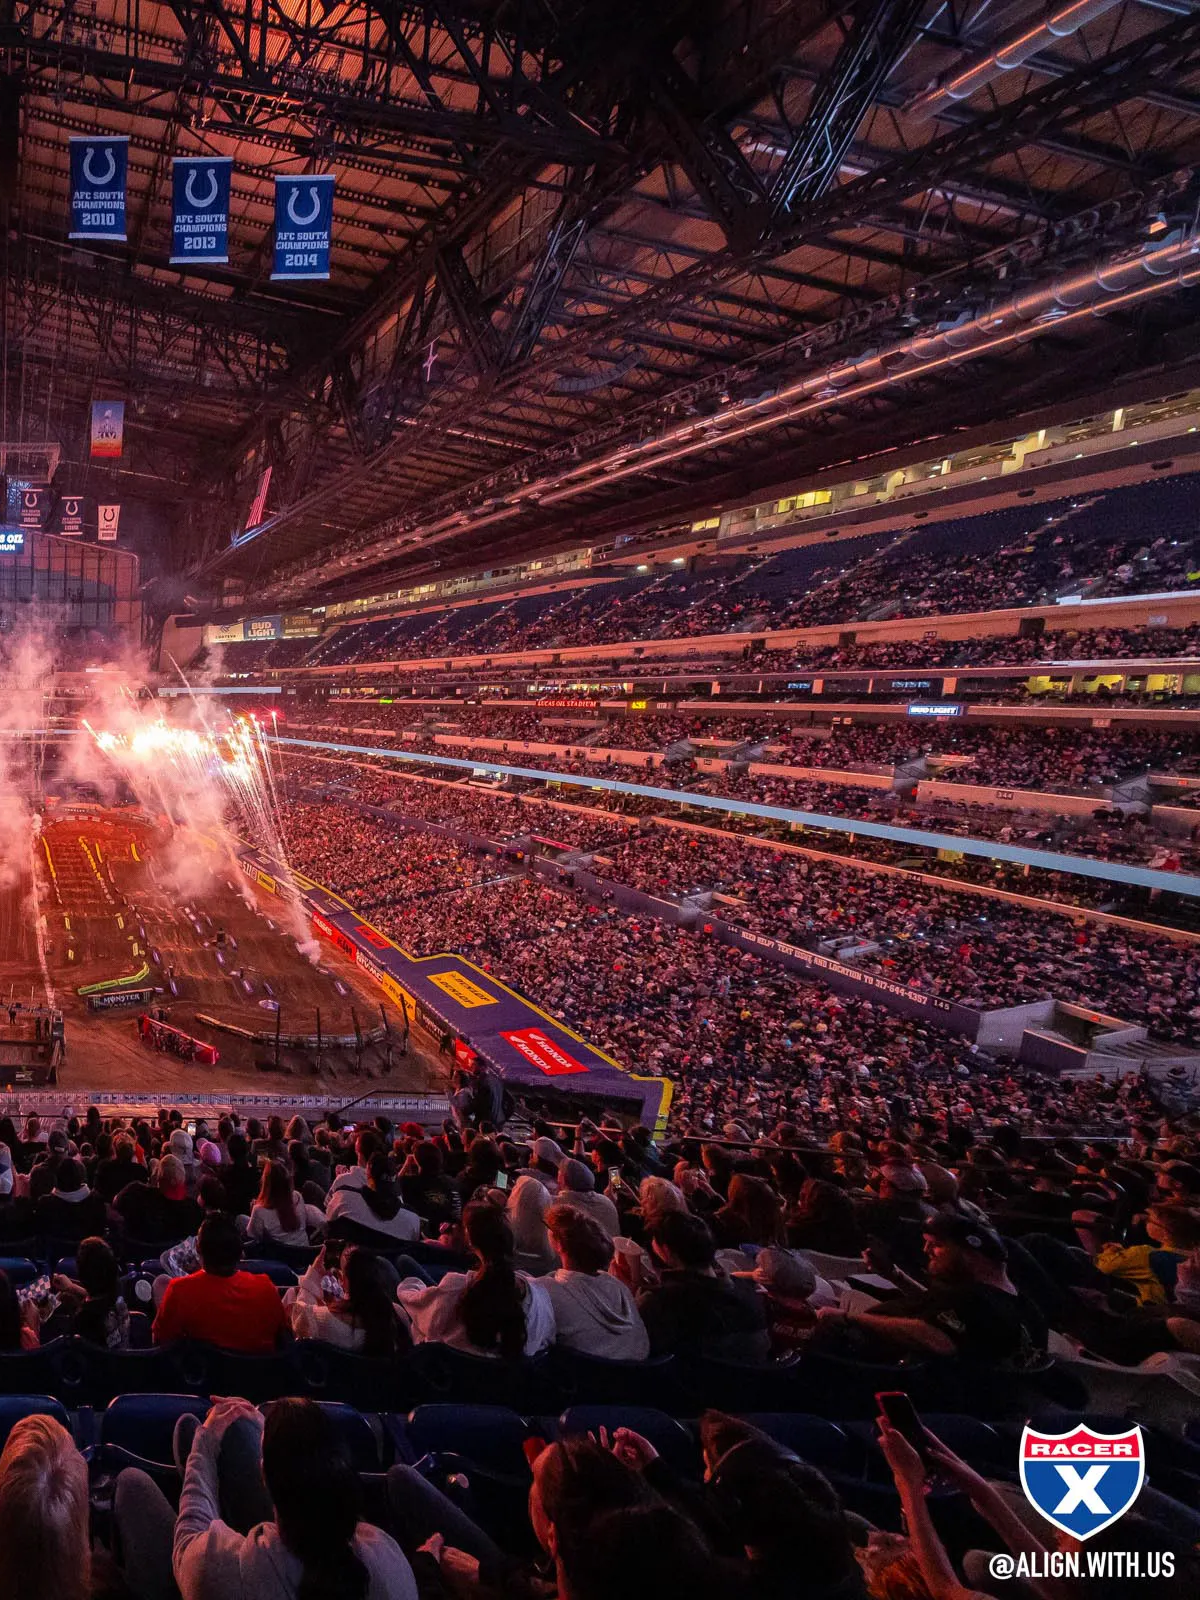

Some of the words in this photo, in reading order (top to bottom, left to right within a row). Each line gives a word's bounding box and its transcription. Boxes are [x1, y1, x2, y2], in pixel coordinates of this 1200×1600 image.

[73, 191, 92, 200] AFC
[93, 191, 124, 201] SOUTH
[72, 200, 125, 210] CHAMPIONS
[82, 212, 115, 226] 2010
[175, 215, 194, 224] AFC
[195, 214, 226, 223] SOUTH
[174, 223, 227, 233] CHAMPIONS
[277, 232, 296, 241] AFC
[297, 231, 328, 241] SOUTH
[183, 236, 216, 250] 2013
[276, 240, 329, 250] CHAMPIONS
[285, 253, 318, 267] 2014
[6, 534, 24, 543] OIL
[251, 621, 272, 630] BUD
[248, 628, 276, 637] LIGHT
[910, 706, 929, 714] BUD
[930, 706, 957, 714] LIGHT
[741, 931, 757, 943] NEED
[757, 936, 775, 949] HELP?
[777, 943, 793, 956] TEXT
[814, 956, 828, 968] AND
[828, 961, 862, 981] LOCATION
[864, 974, 874, 985] TO
[875, 979, 928, 1004] 317-644-4357
[440, 980, 475, 1005] DUNLOP
[455, 978, 490, 1002] DUNLOP
[103, 993, 140, 1004] MONSTER
[933, 999, 950, 1011] 145
[517, 1043, 552, 1070] HONDA
[538, 1039, 573, 1069] HONDA
